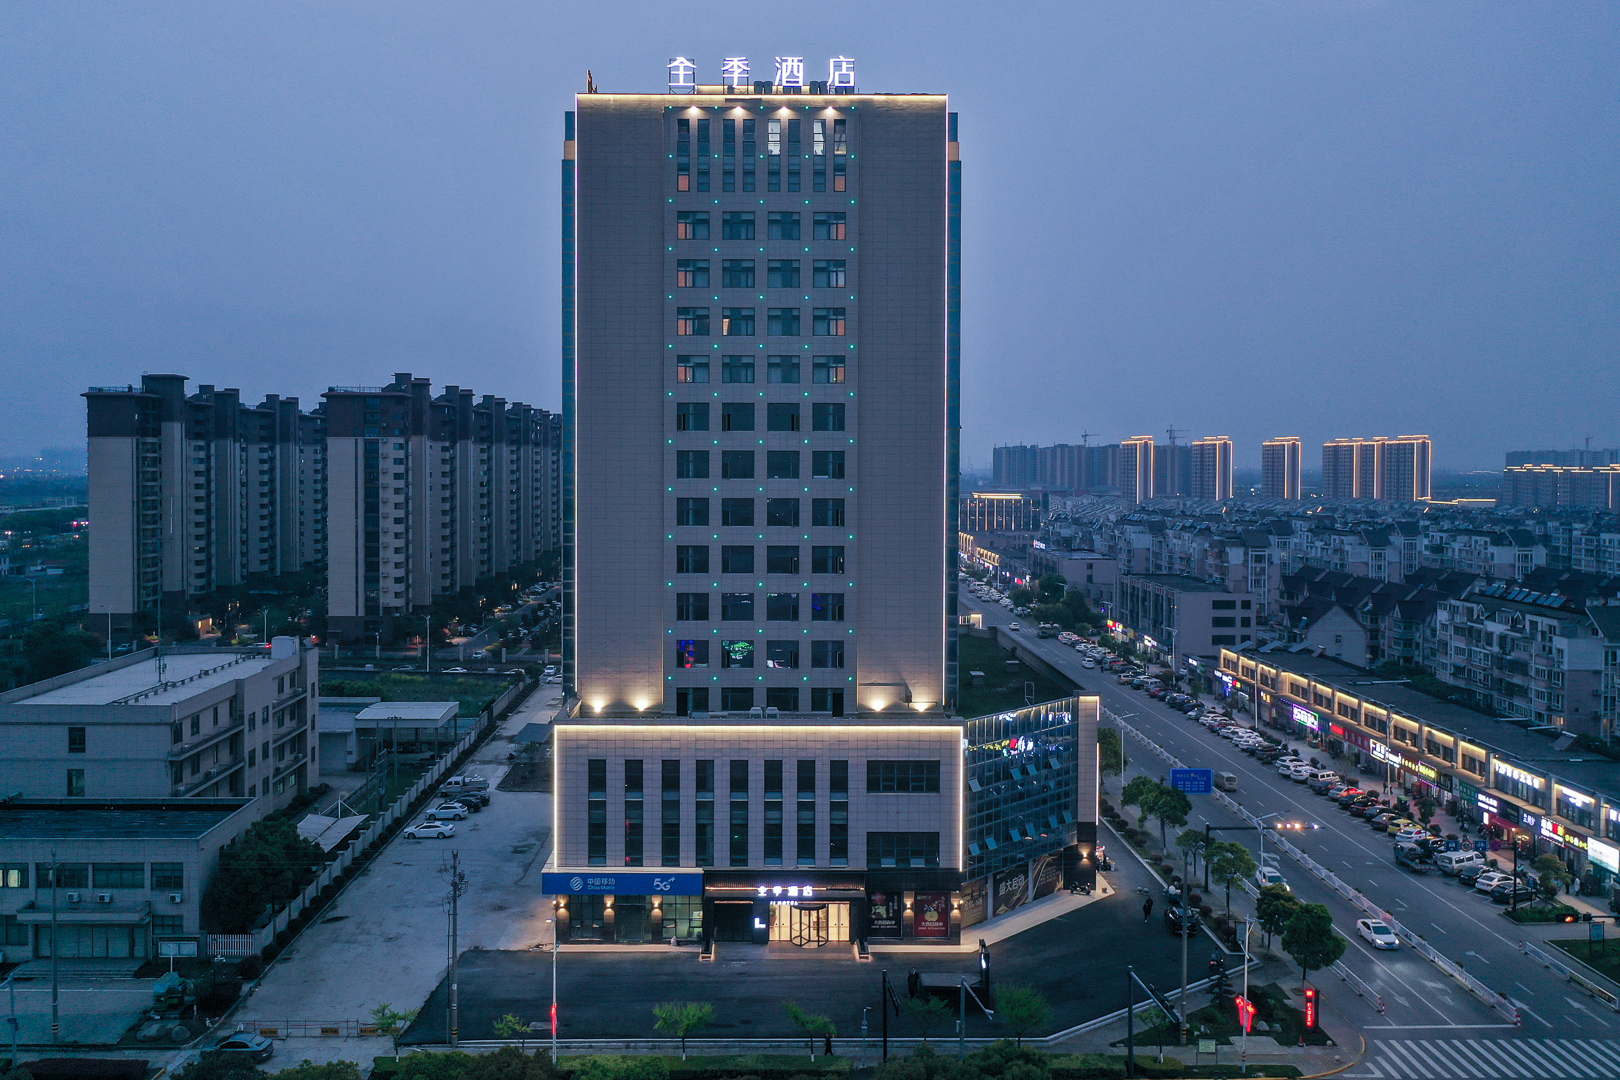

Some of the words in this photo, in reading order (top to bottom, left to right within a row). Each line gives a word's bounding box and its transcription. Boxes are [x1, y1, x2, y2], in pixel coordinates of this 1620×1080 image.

[666, 55, 855, 88] 全季酒店
[587, 877, 616, 885] 中国移动
[653, 878, 671, 891] 5G
[757, 885, 813, 897] 全季酒店
